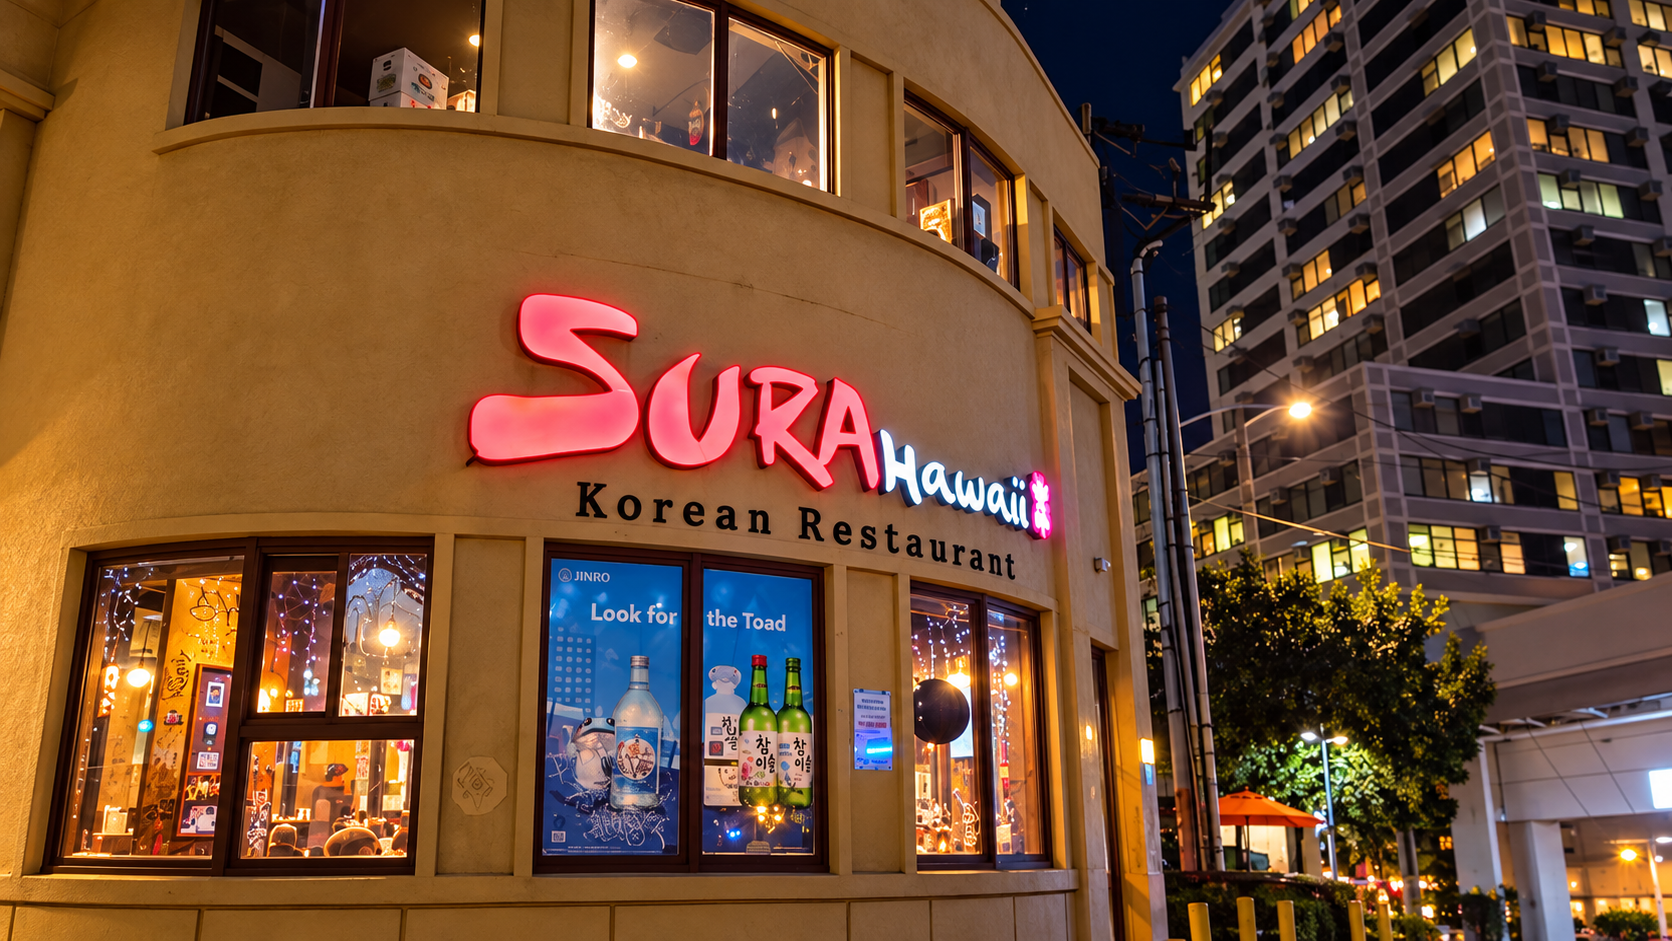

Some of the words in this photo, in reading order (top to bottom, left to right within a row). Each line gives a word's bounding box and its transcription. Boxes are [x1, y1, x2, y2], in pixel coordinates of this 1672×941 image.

[468, 293, 881, 492] SURA
[879, 429, 1030, 531] Hawaii
[575, 481, 771, 535] Korean
[798, 507, 1016, 580] Restaurant
[574, 571, 610, 583] JINRO
[591, 603, 642, 623] Look
[647, 604, 678, 625] for
[707, 609, 738, 628] the
[742, 612, 786, 632] Toad
